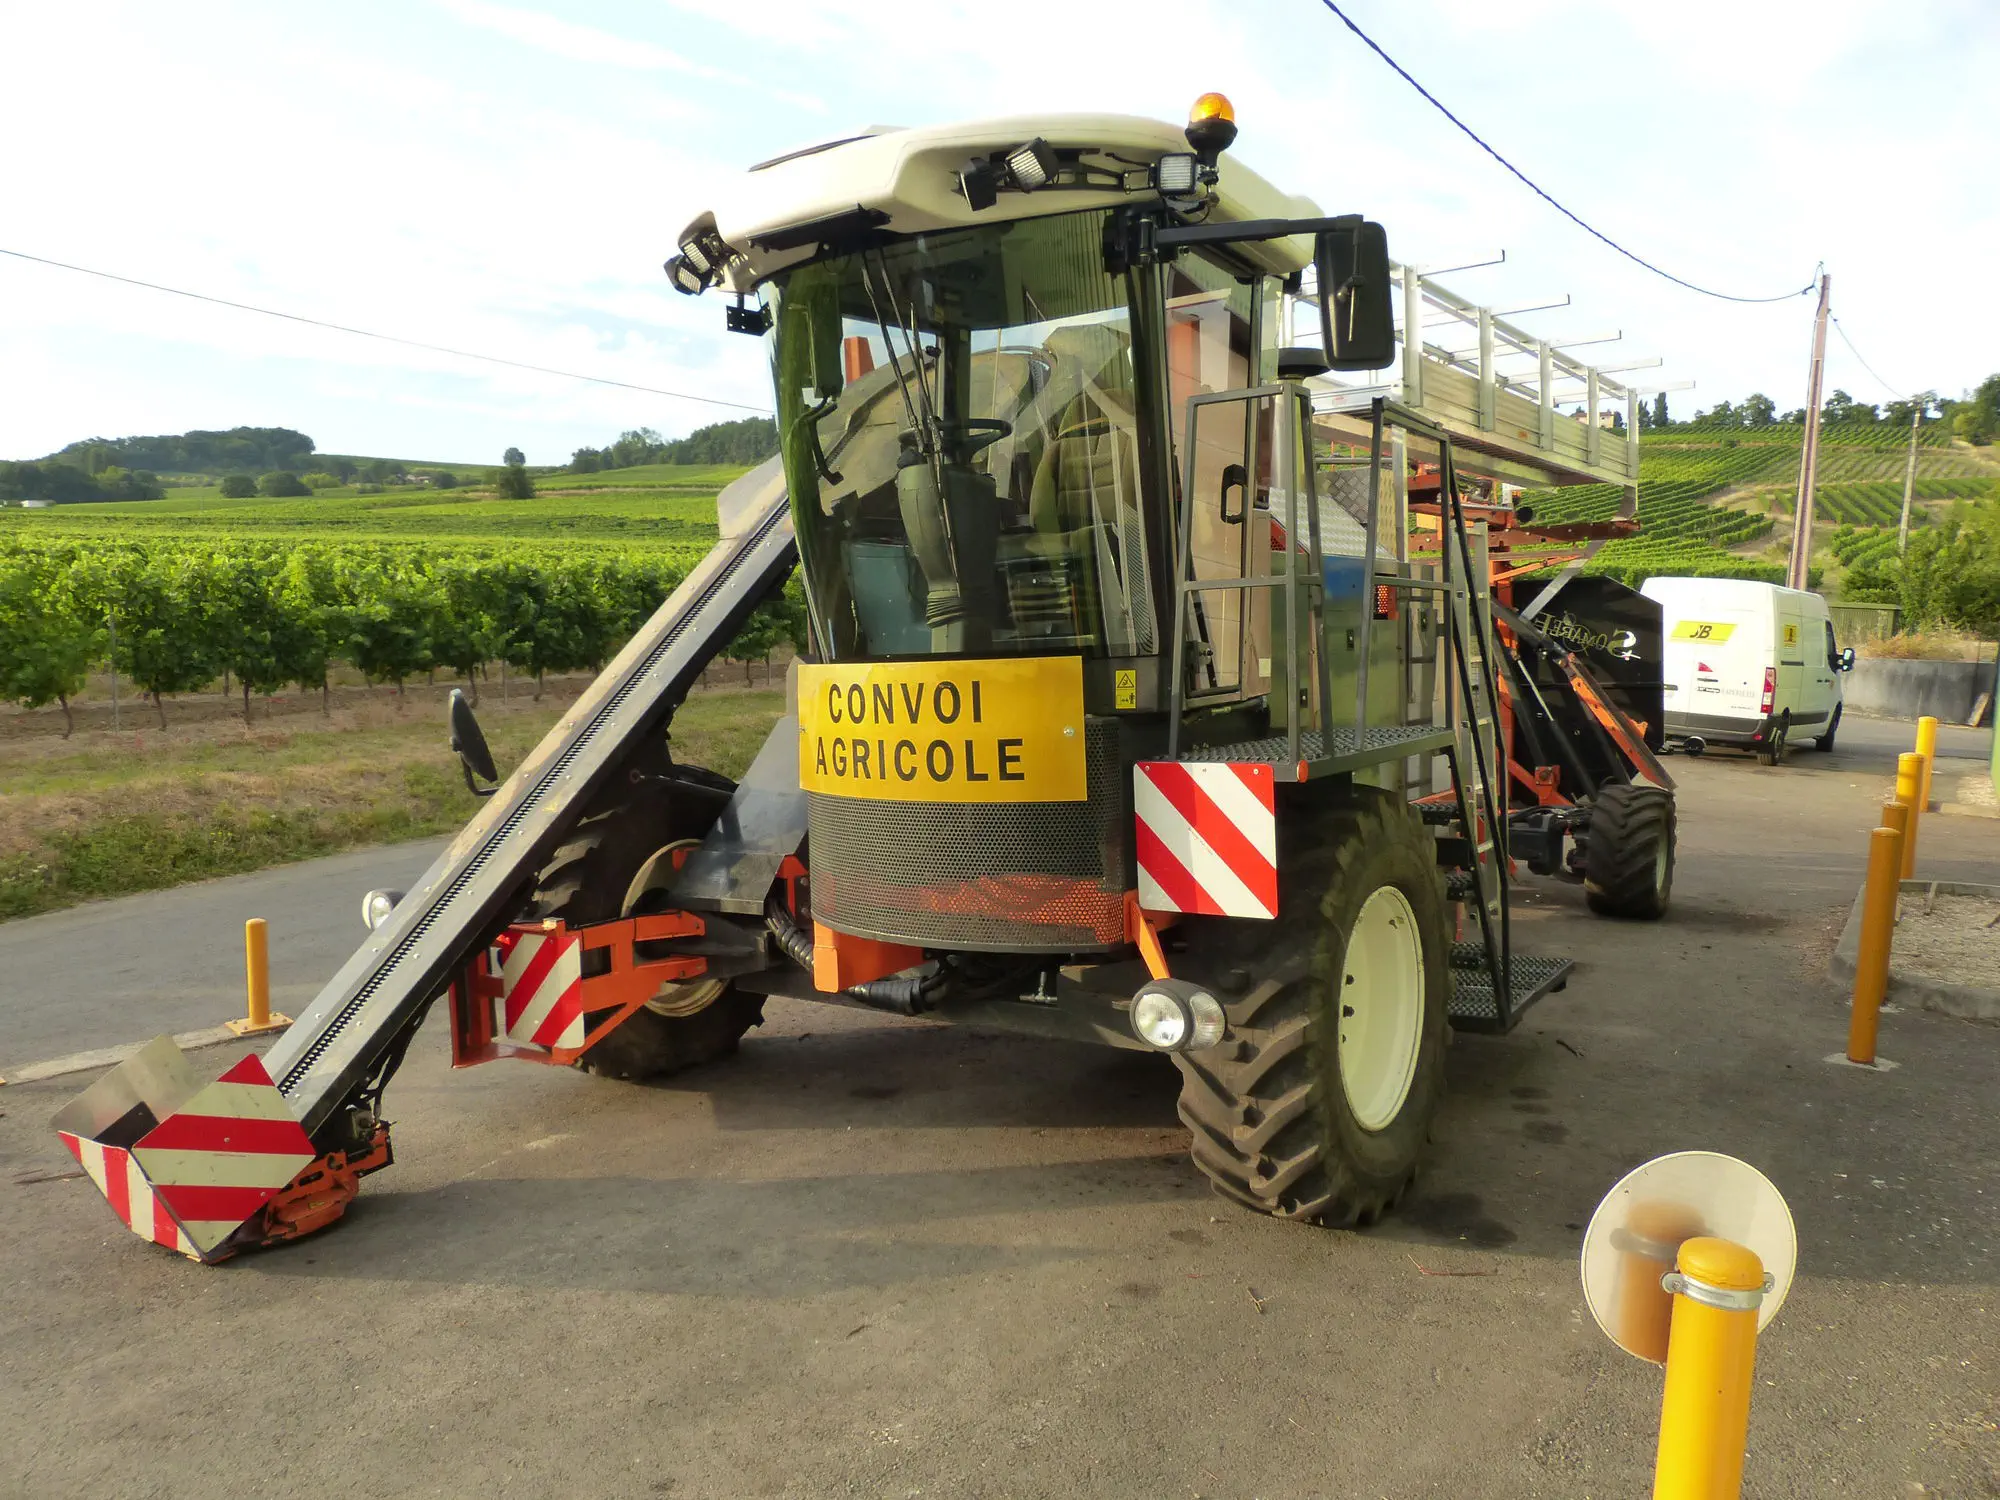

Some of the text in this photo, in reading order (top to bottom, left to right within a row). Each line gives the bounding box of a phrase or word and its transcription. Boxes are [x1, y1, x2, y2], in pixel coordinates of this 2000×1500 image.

[1689, 624, 1713, 639] JB
[828, 680, 983, 725] CONVOI
[815, 736, 1026, 783] AGRICOLE
